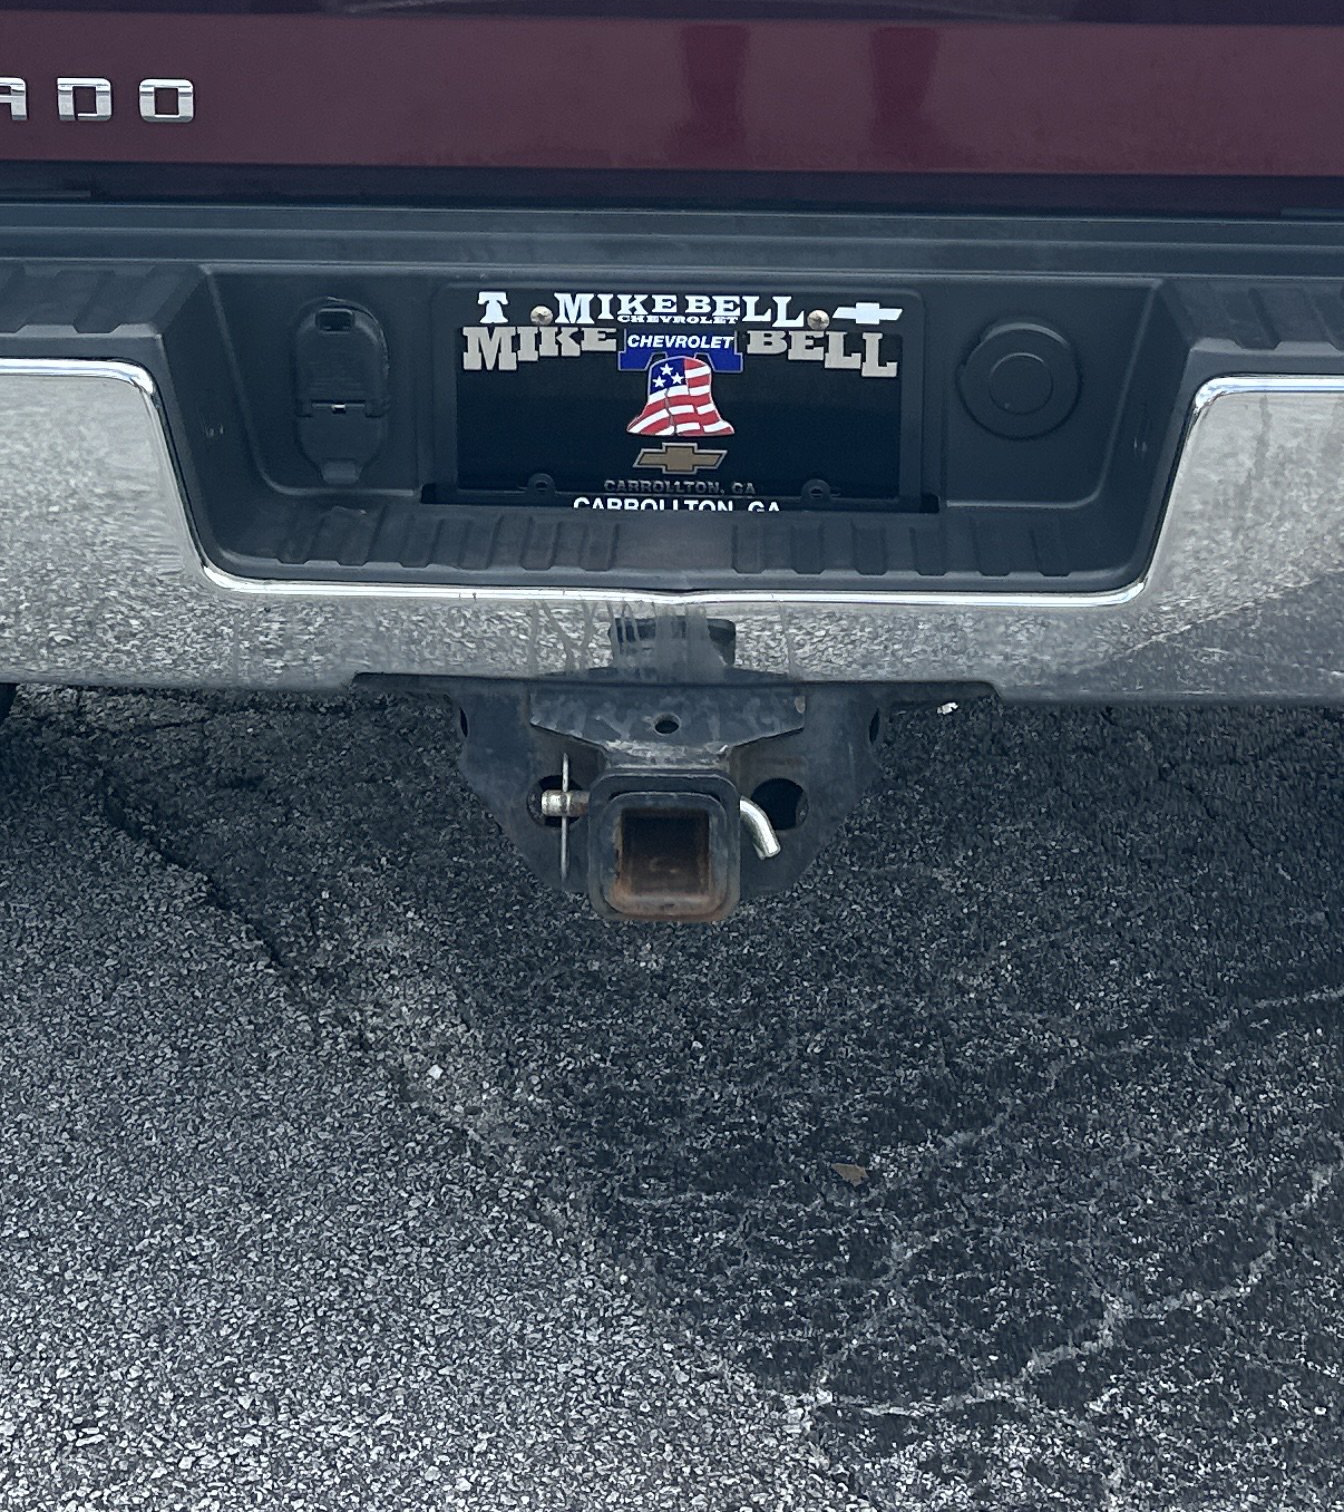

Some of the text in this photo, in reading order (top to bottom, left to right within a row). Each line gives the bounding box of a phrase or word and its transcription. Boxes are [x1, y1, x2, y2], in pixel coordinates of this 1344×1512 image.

[554, 292, 805, 328] MIKE BELL
[617, 314, 739, 325] CHEVROLET
[627, 334, 735, 350] CHEVROLET
[463, 326, 898, 377] MIKE BELL
[731, 482, 756, 495] GA
